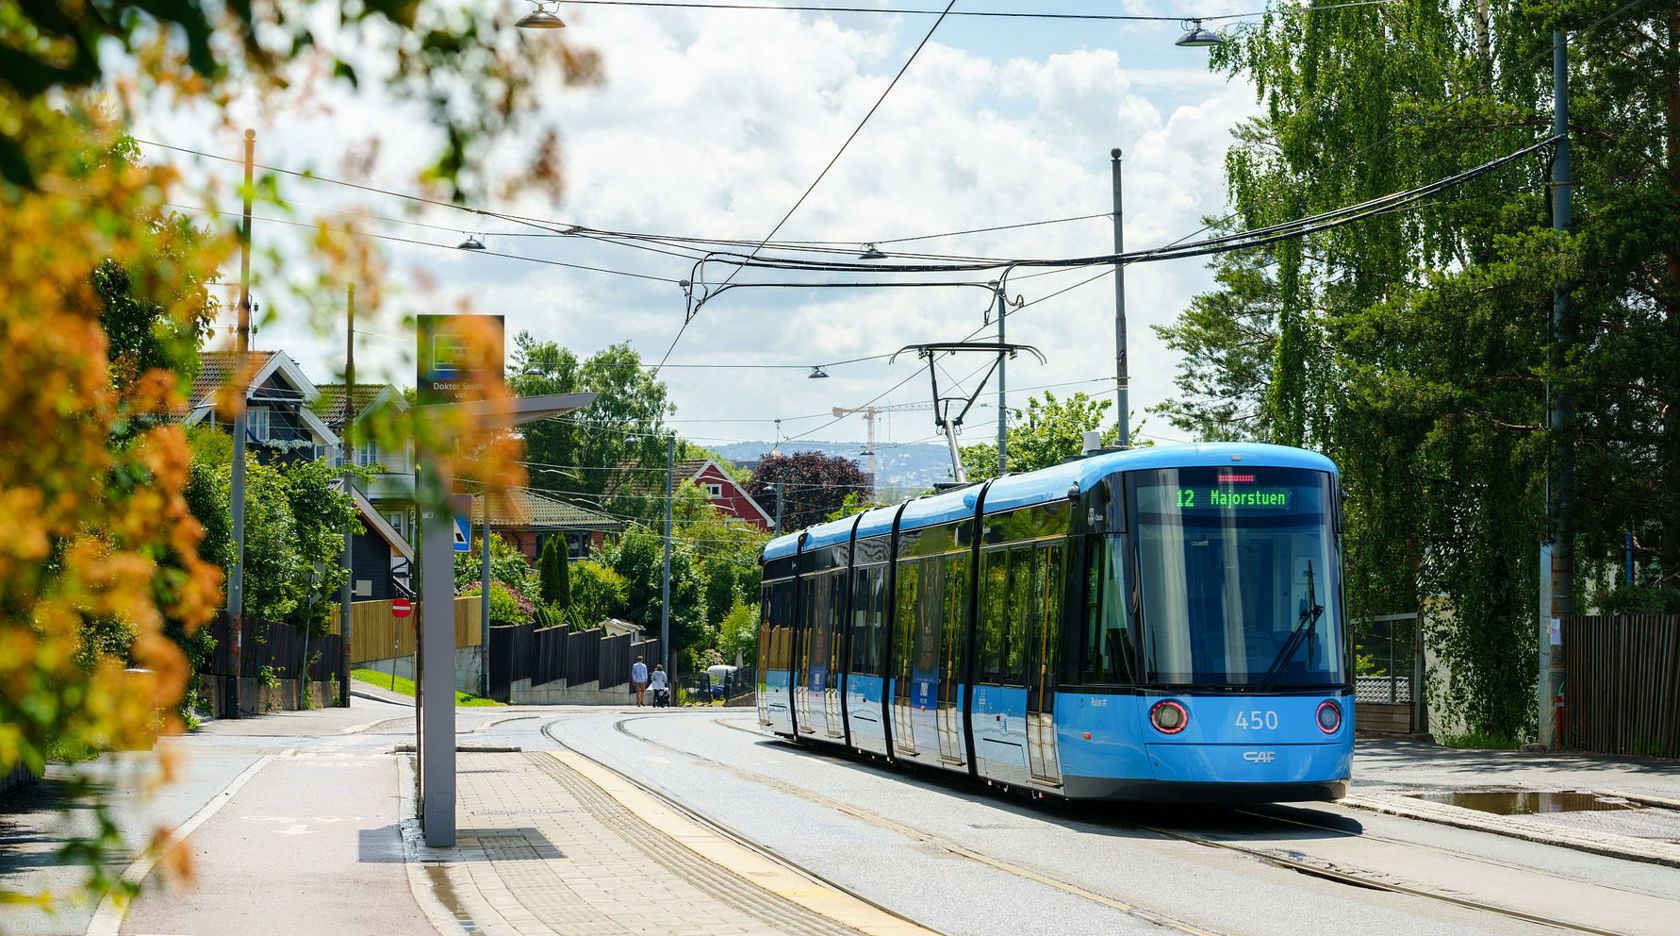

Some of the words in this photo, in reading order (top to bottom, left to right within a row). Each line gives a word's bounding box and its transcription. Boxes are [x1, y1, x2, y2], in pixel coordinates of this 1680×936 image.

[433, 382, 460, 391] Doktor
[462, 382, 488, 391] Smith
[1176, 489, 1194, 507] 12
[1210, 489, 1286, 509] Majorstuen
[1235, 710, 1279, 730] 450
[1242, 751, 1276, 763] CAF
